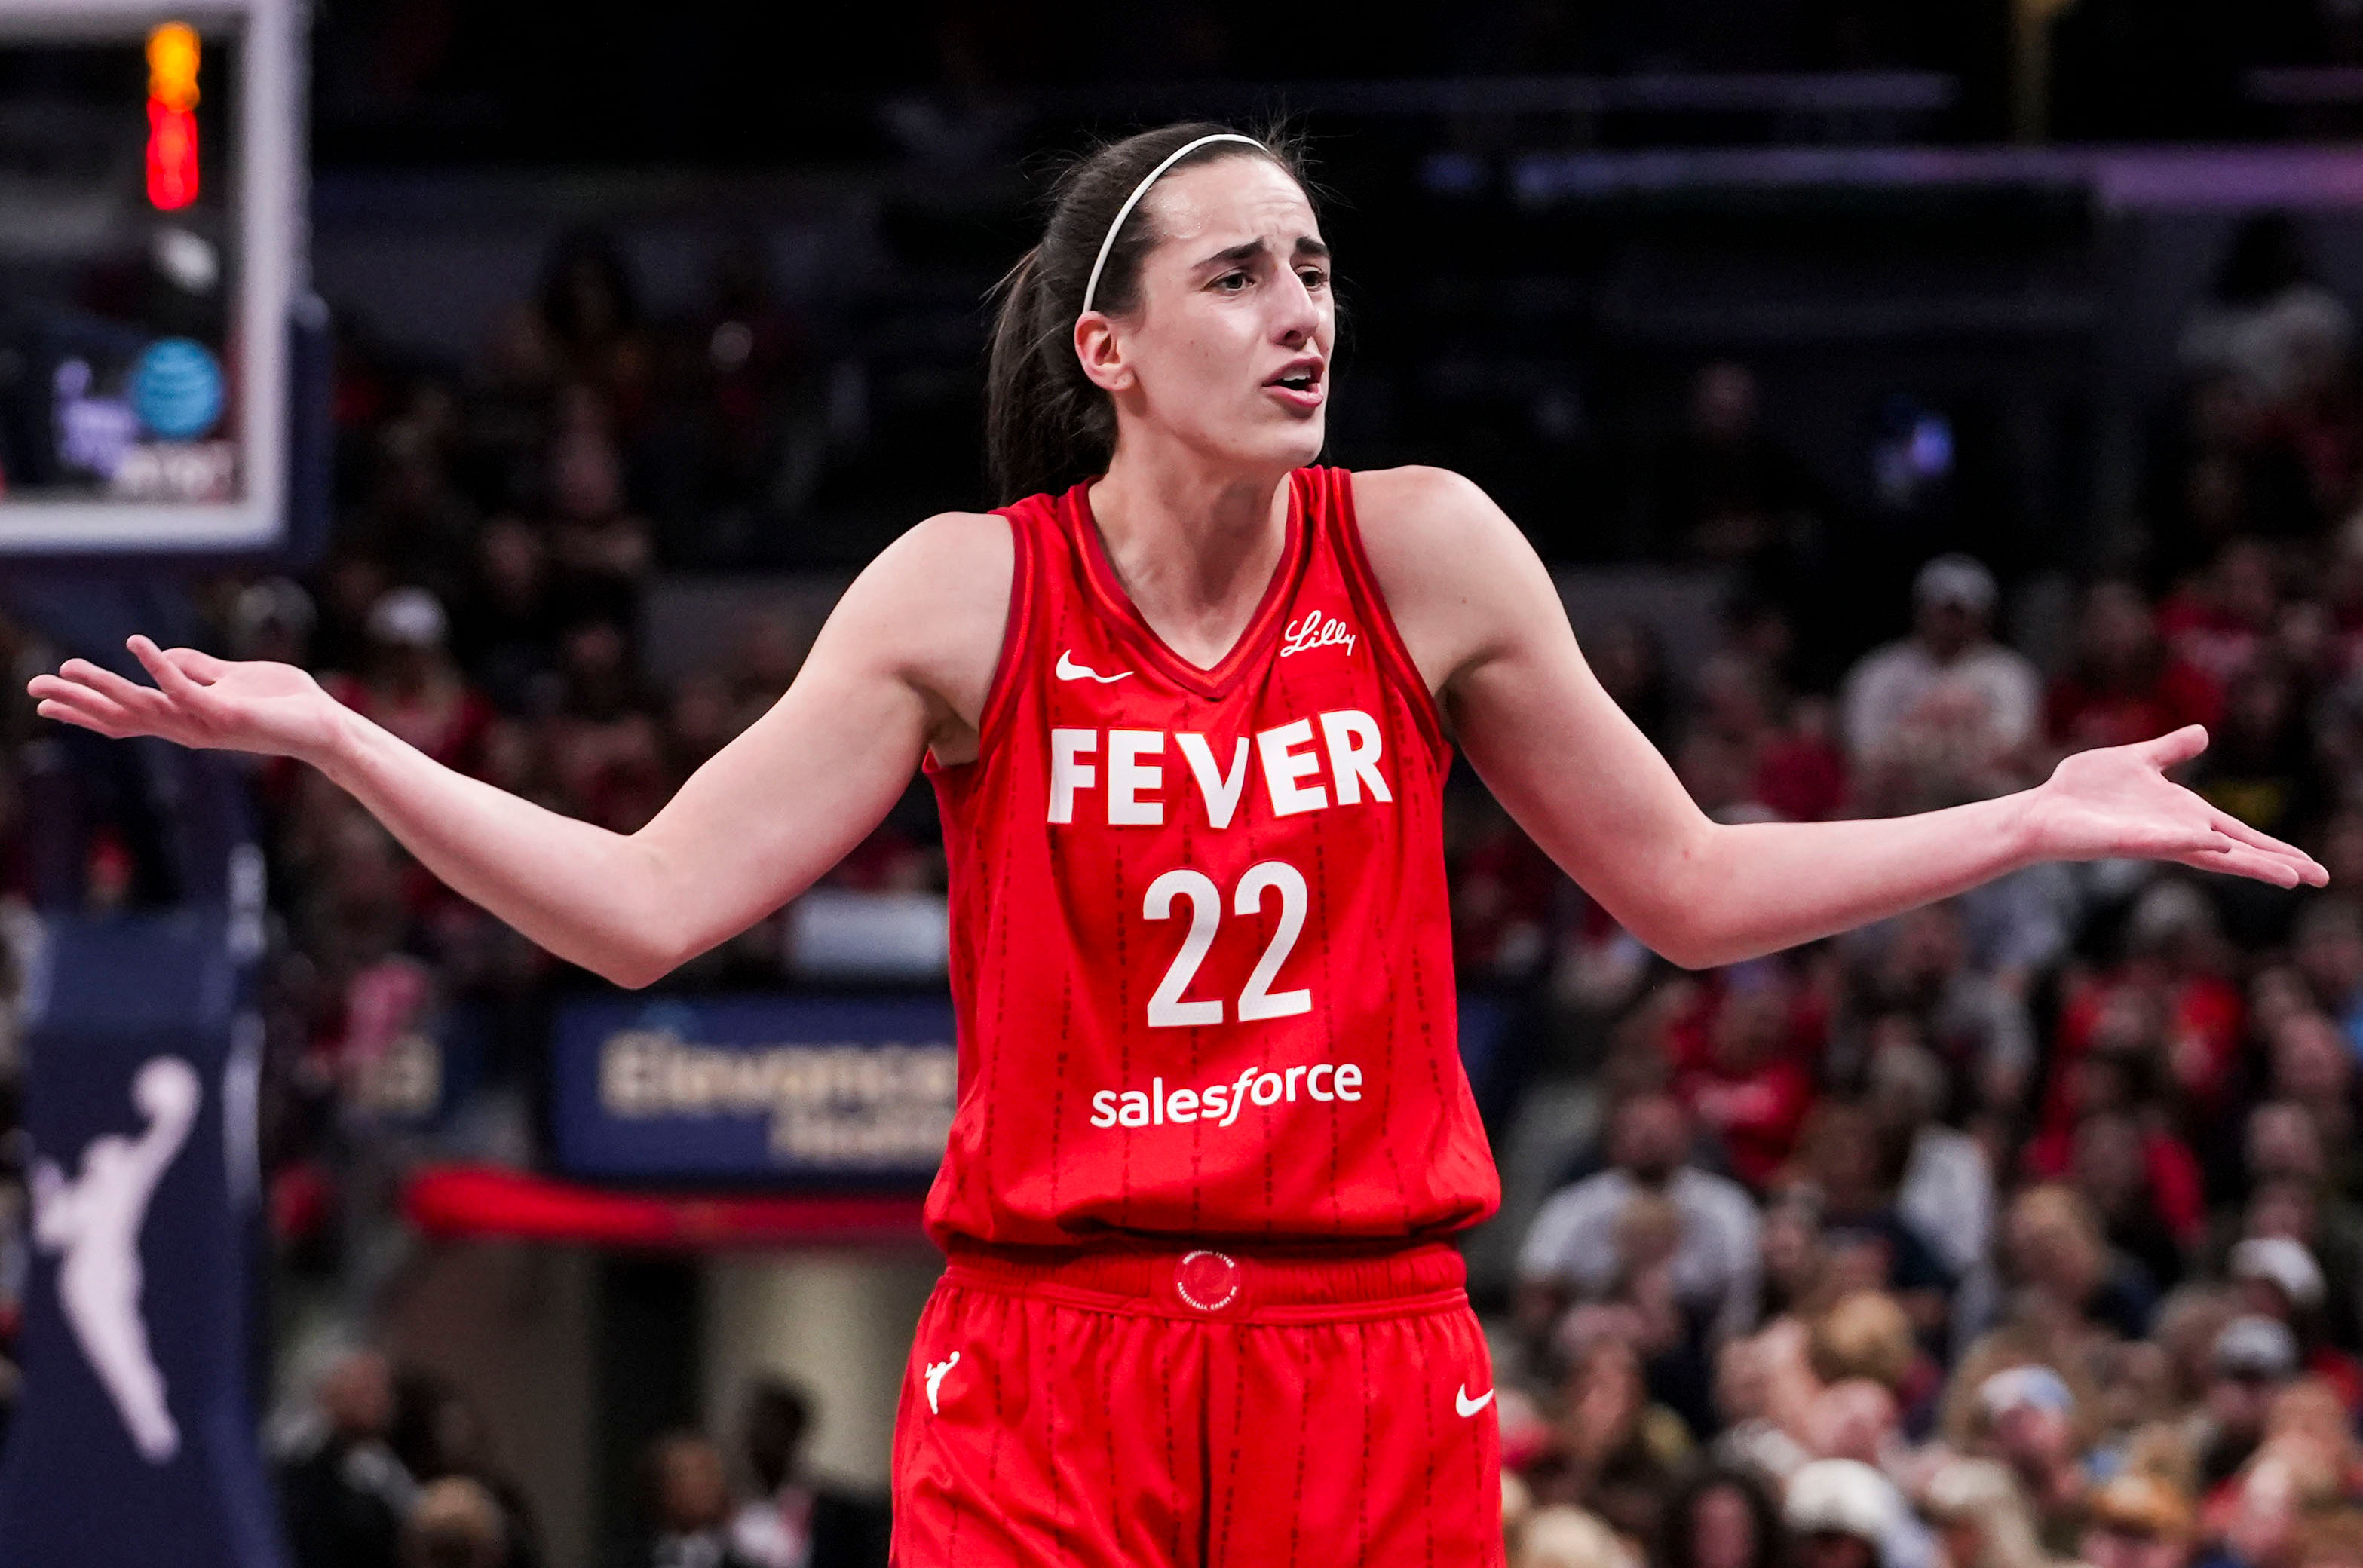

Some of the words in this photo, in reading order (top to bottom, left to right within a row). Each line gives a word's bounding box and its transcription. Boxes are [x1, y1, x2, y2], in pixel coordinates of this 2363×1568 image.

[1280, 610, 1356, 658] Lilly
[1047, 709, 1393, 829] FEVER
[1143, 861, 1312, 1027] 22
[1090, 1064, 1362, 1128] salesforce
